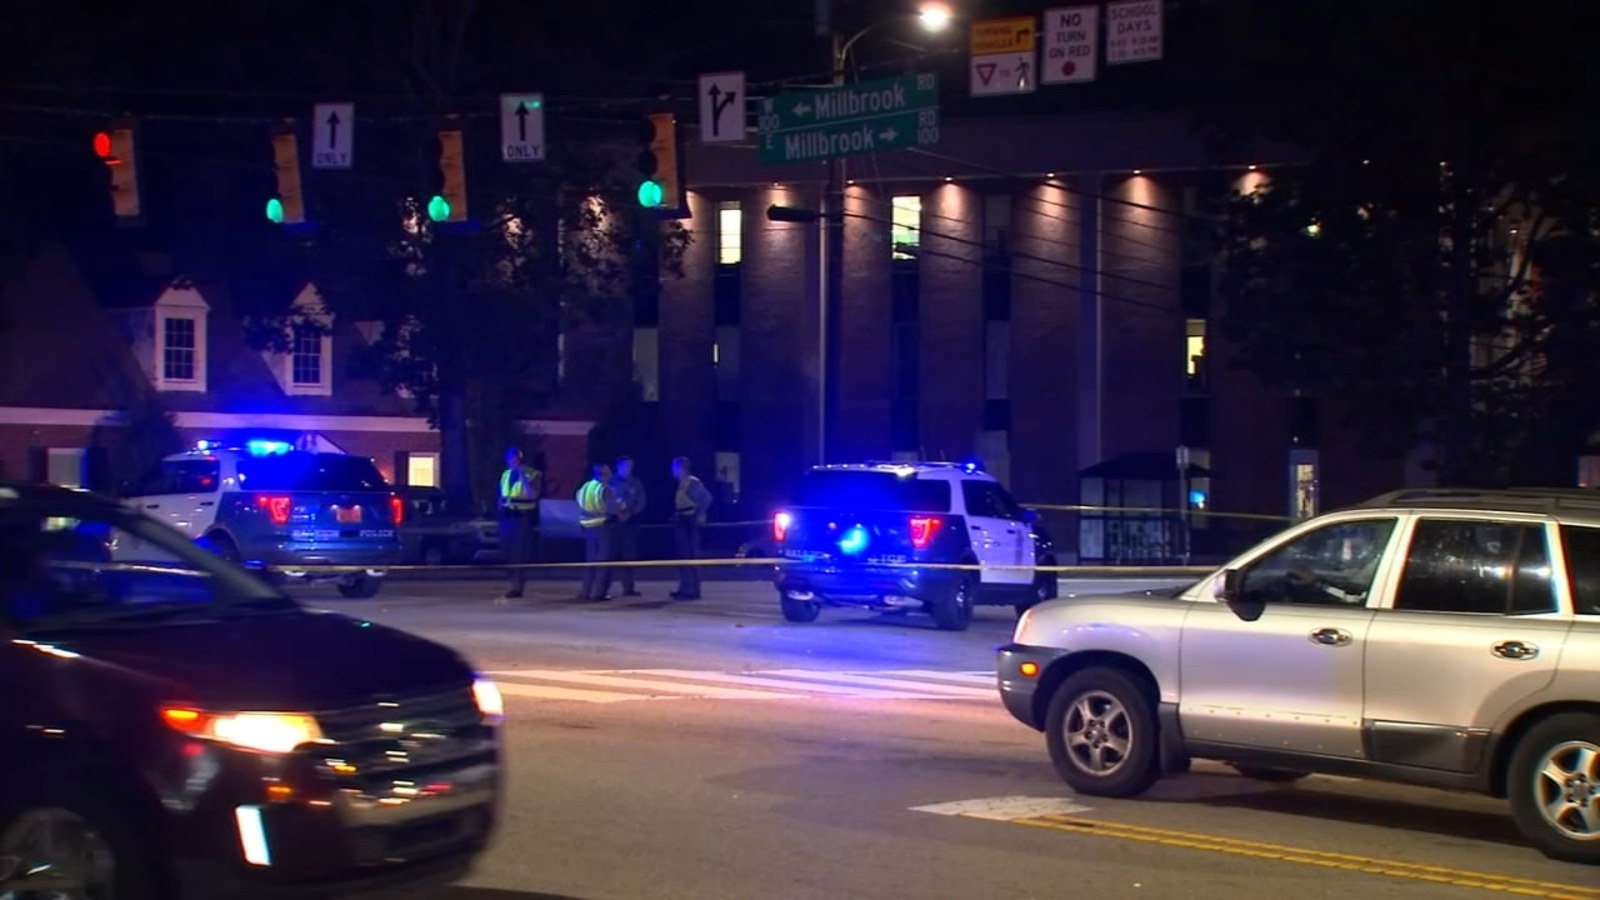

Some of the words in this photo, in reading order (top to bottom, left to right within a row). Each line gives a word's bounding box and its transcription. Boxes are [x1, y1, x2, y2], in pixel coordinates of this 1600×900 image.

[1110, 4, 1158, 20] SCHOOL
[1060, 13, 1081, 28] NO
[1116, 20, 1151, 35] DAYS
[1056, 30, 1086, 43] TURN
[1049, 47, 1065, 59] ON
[1068, 45, 1090, 57] RED
[814, 84, 906, 119] Millbrook
[917, 73, 935, 90] RD
[763, 99, 774, 113] W
[759, 114, 780, 130] 100
[765, 135, 774, 150] E
[785, 127, 874, 160] Millbrook
[919, 110, 936, 127] RD
[917, 127, 939, 144] 100
[316, 152, 347, 164] ONLY
[506, 144, 540, 157] ONLY
